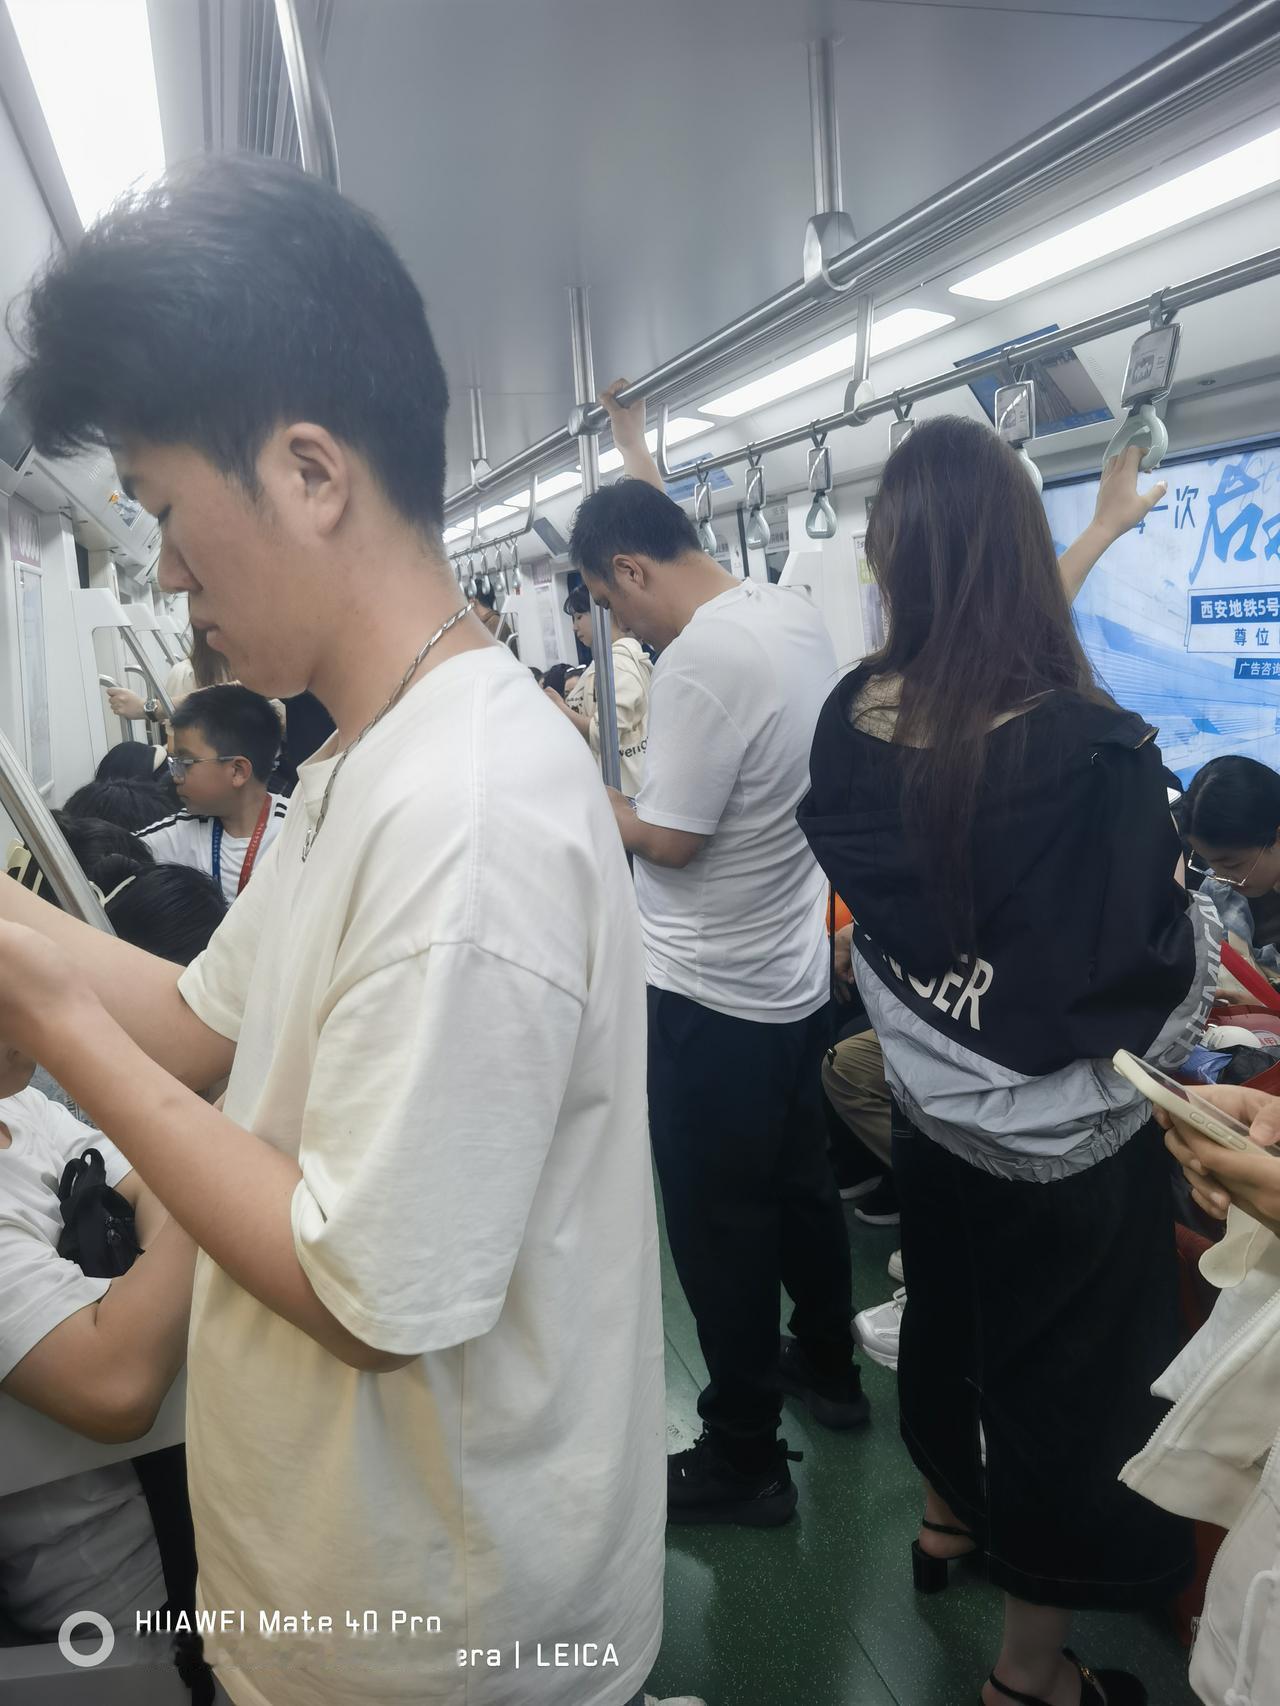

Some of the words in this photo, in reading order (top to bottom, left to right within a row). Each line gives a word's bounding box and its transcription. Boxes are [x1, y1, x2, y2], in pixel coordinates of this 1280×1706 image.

[1200, 597, 1280, 619] 西安地铁5号
[1233, 627, 1280, 646] 尊位
